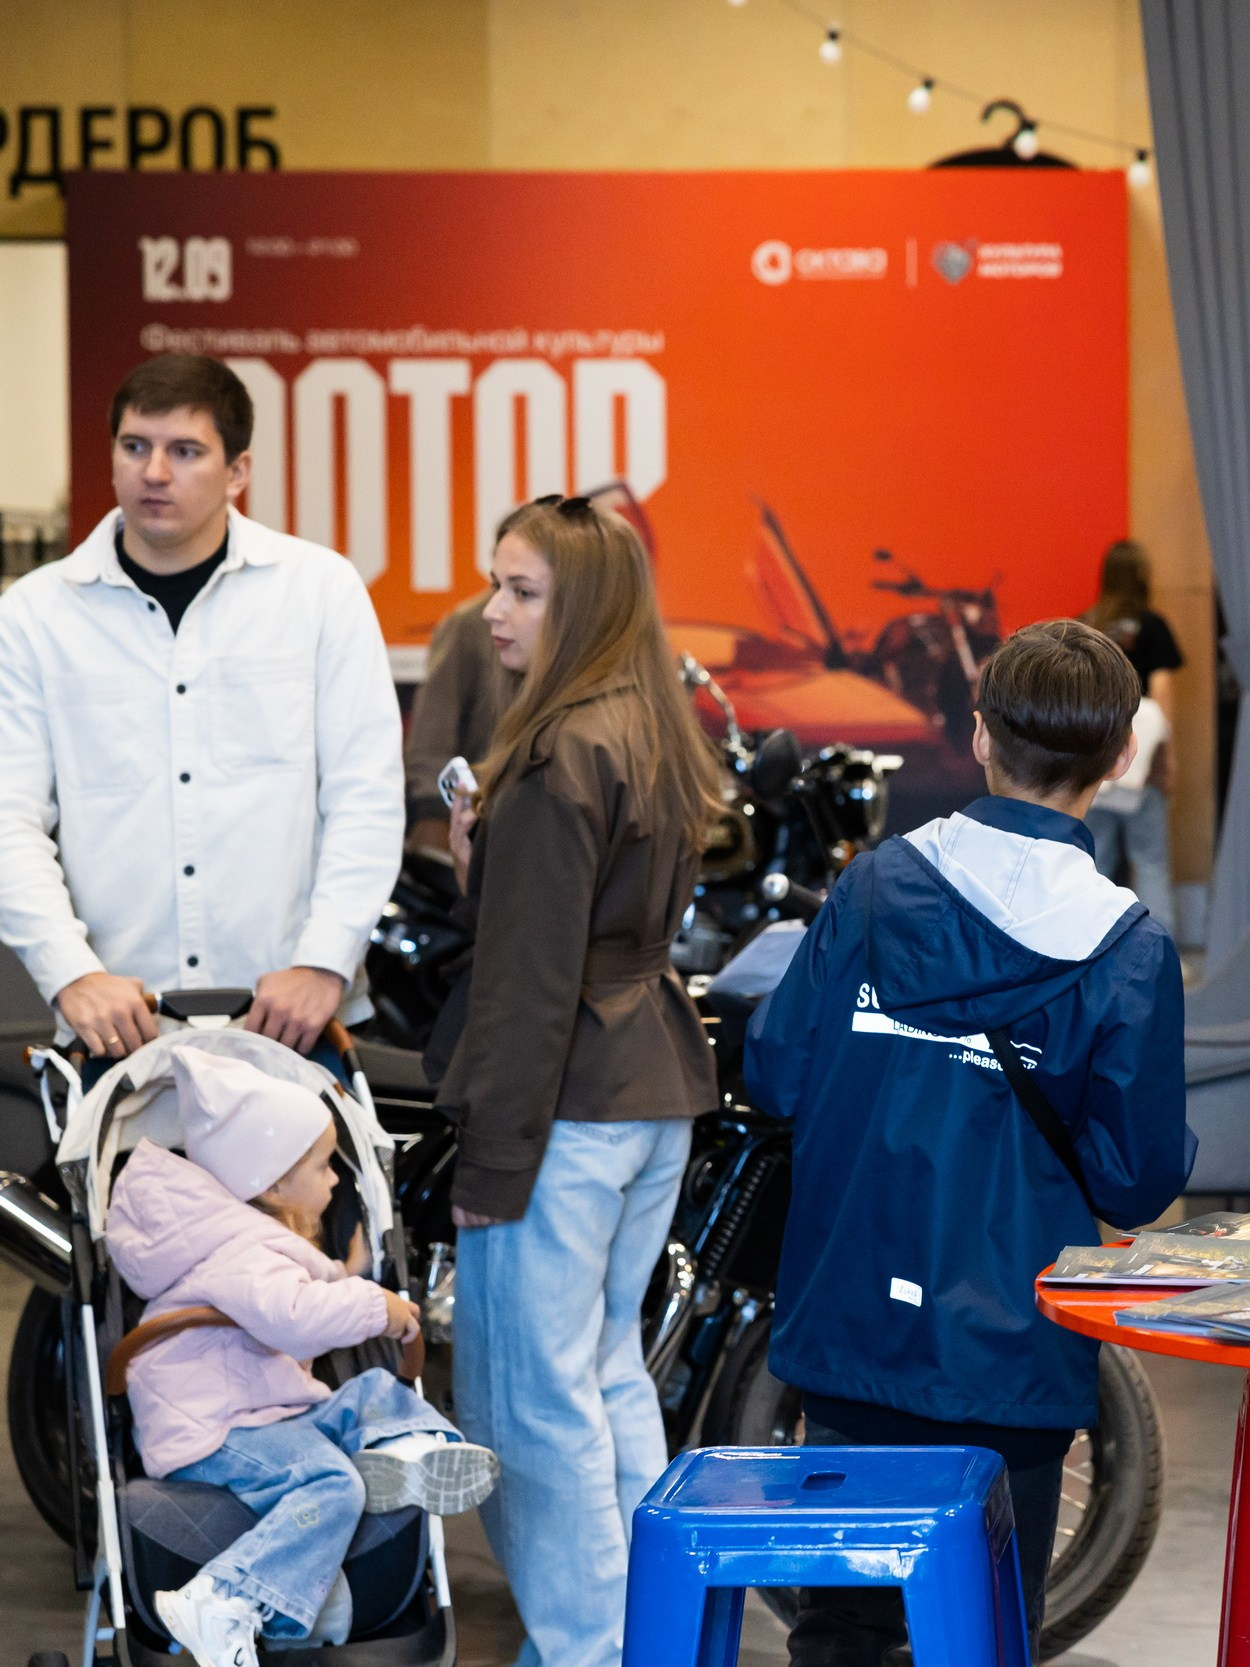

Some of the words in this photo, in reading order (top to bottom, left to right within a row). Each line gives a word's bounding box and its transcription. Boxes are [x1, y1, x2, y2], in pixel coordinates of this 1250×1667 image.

[0, 105, 280, 198] ДЕРОБ
[139, 236, 233, 301] 12.09
[139, 323, 300, 353] Фестиваль
[304, 324, 528, 354] автомобильной
[532, 328, 665, 359] культуры
